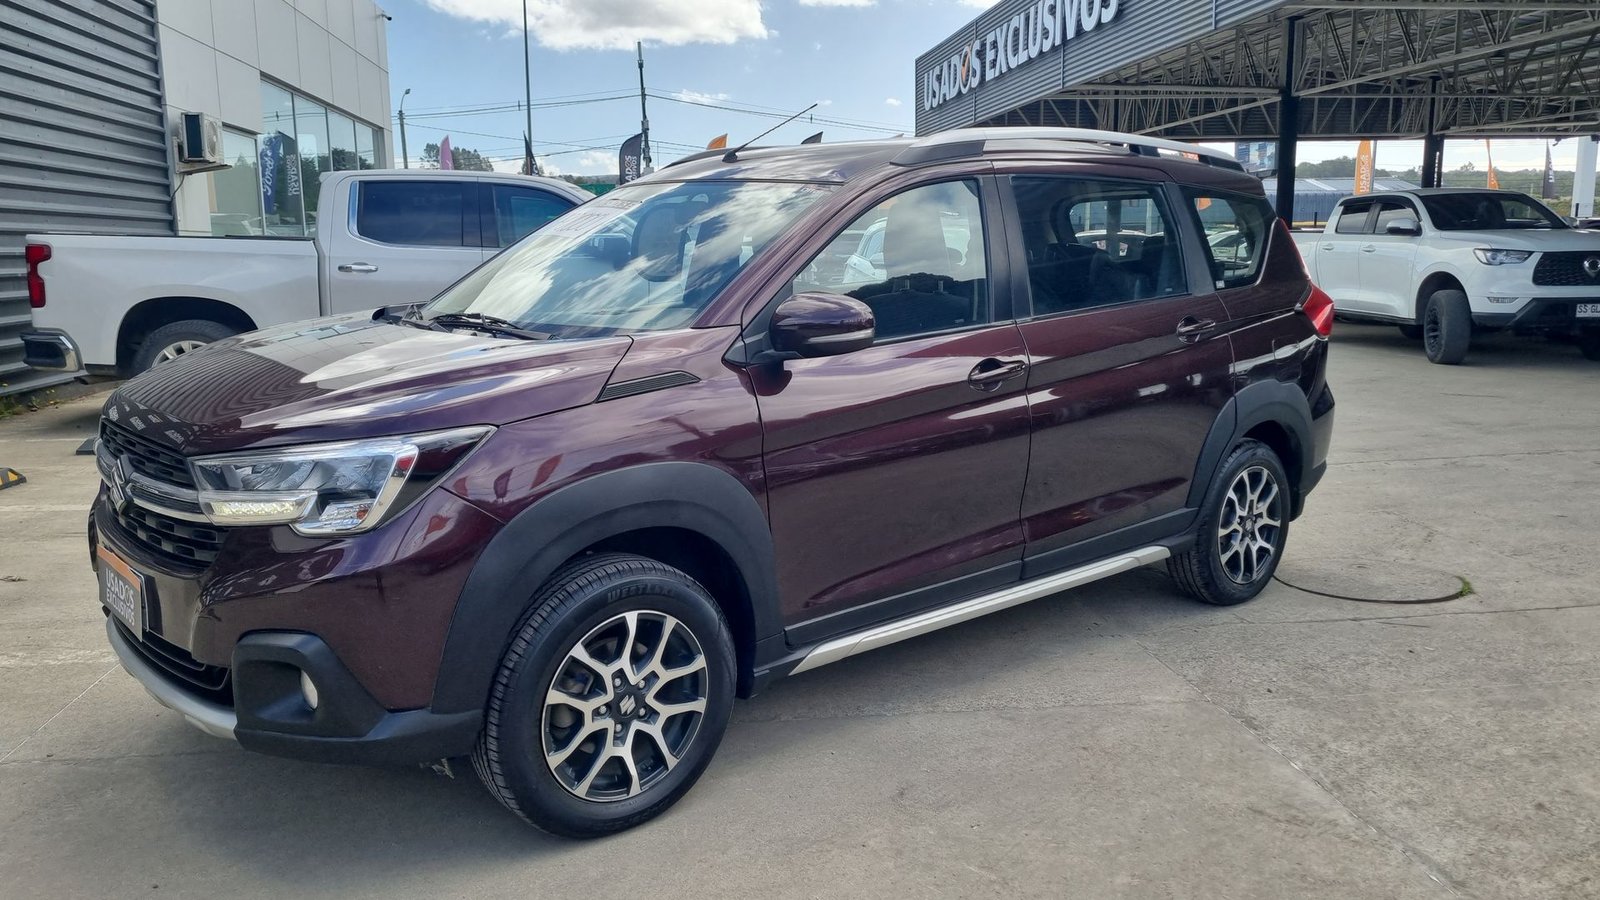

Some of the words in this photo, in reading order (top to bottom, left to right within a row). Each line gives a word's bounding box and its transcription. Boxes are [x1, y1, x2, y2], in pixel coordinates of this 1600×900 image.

[924, 39, 982, 111] USADOS
[624, 155, 633, 182] ADOS
[105, 567, 135, 610] USADOS
[106, 587, 135, 627] EXCLUSIVOS
